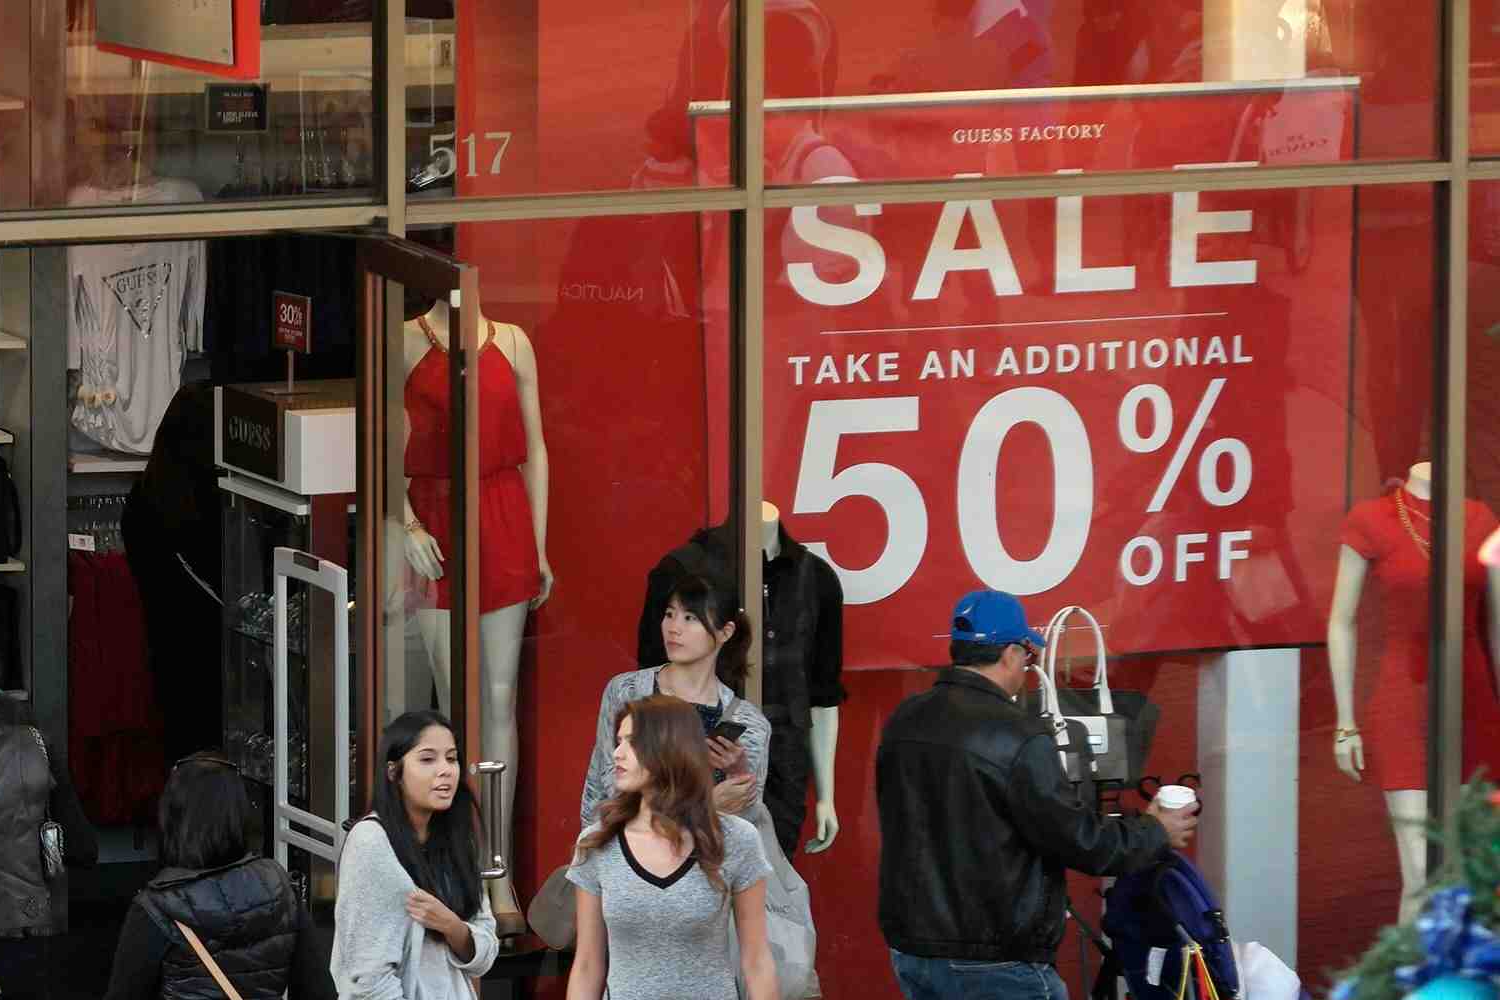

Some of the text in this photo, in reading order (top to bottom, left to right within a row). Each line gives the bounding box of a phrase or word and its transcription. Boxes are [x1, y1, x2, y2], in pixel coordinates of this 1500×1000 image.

[429, 131, 512, 178] 517
[953, 123, 1106, 145] GUESS FACTORY
[786, 162, 1258, 306] SALE
[787, 335, 1253, 386] TAKE AN ADDITIONAL
[791, 378, 1253, 605] 50%
[1120, 530, 1253, 586] OFF
